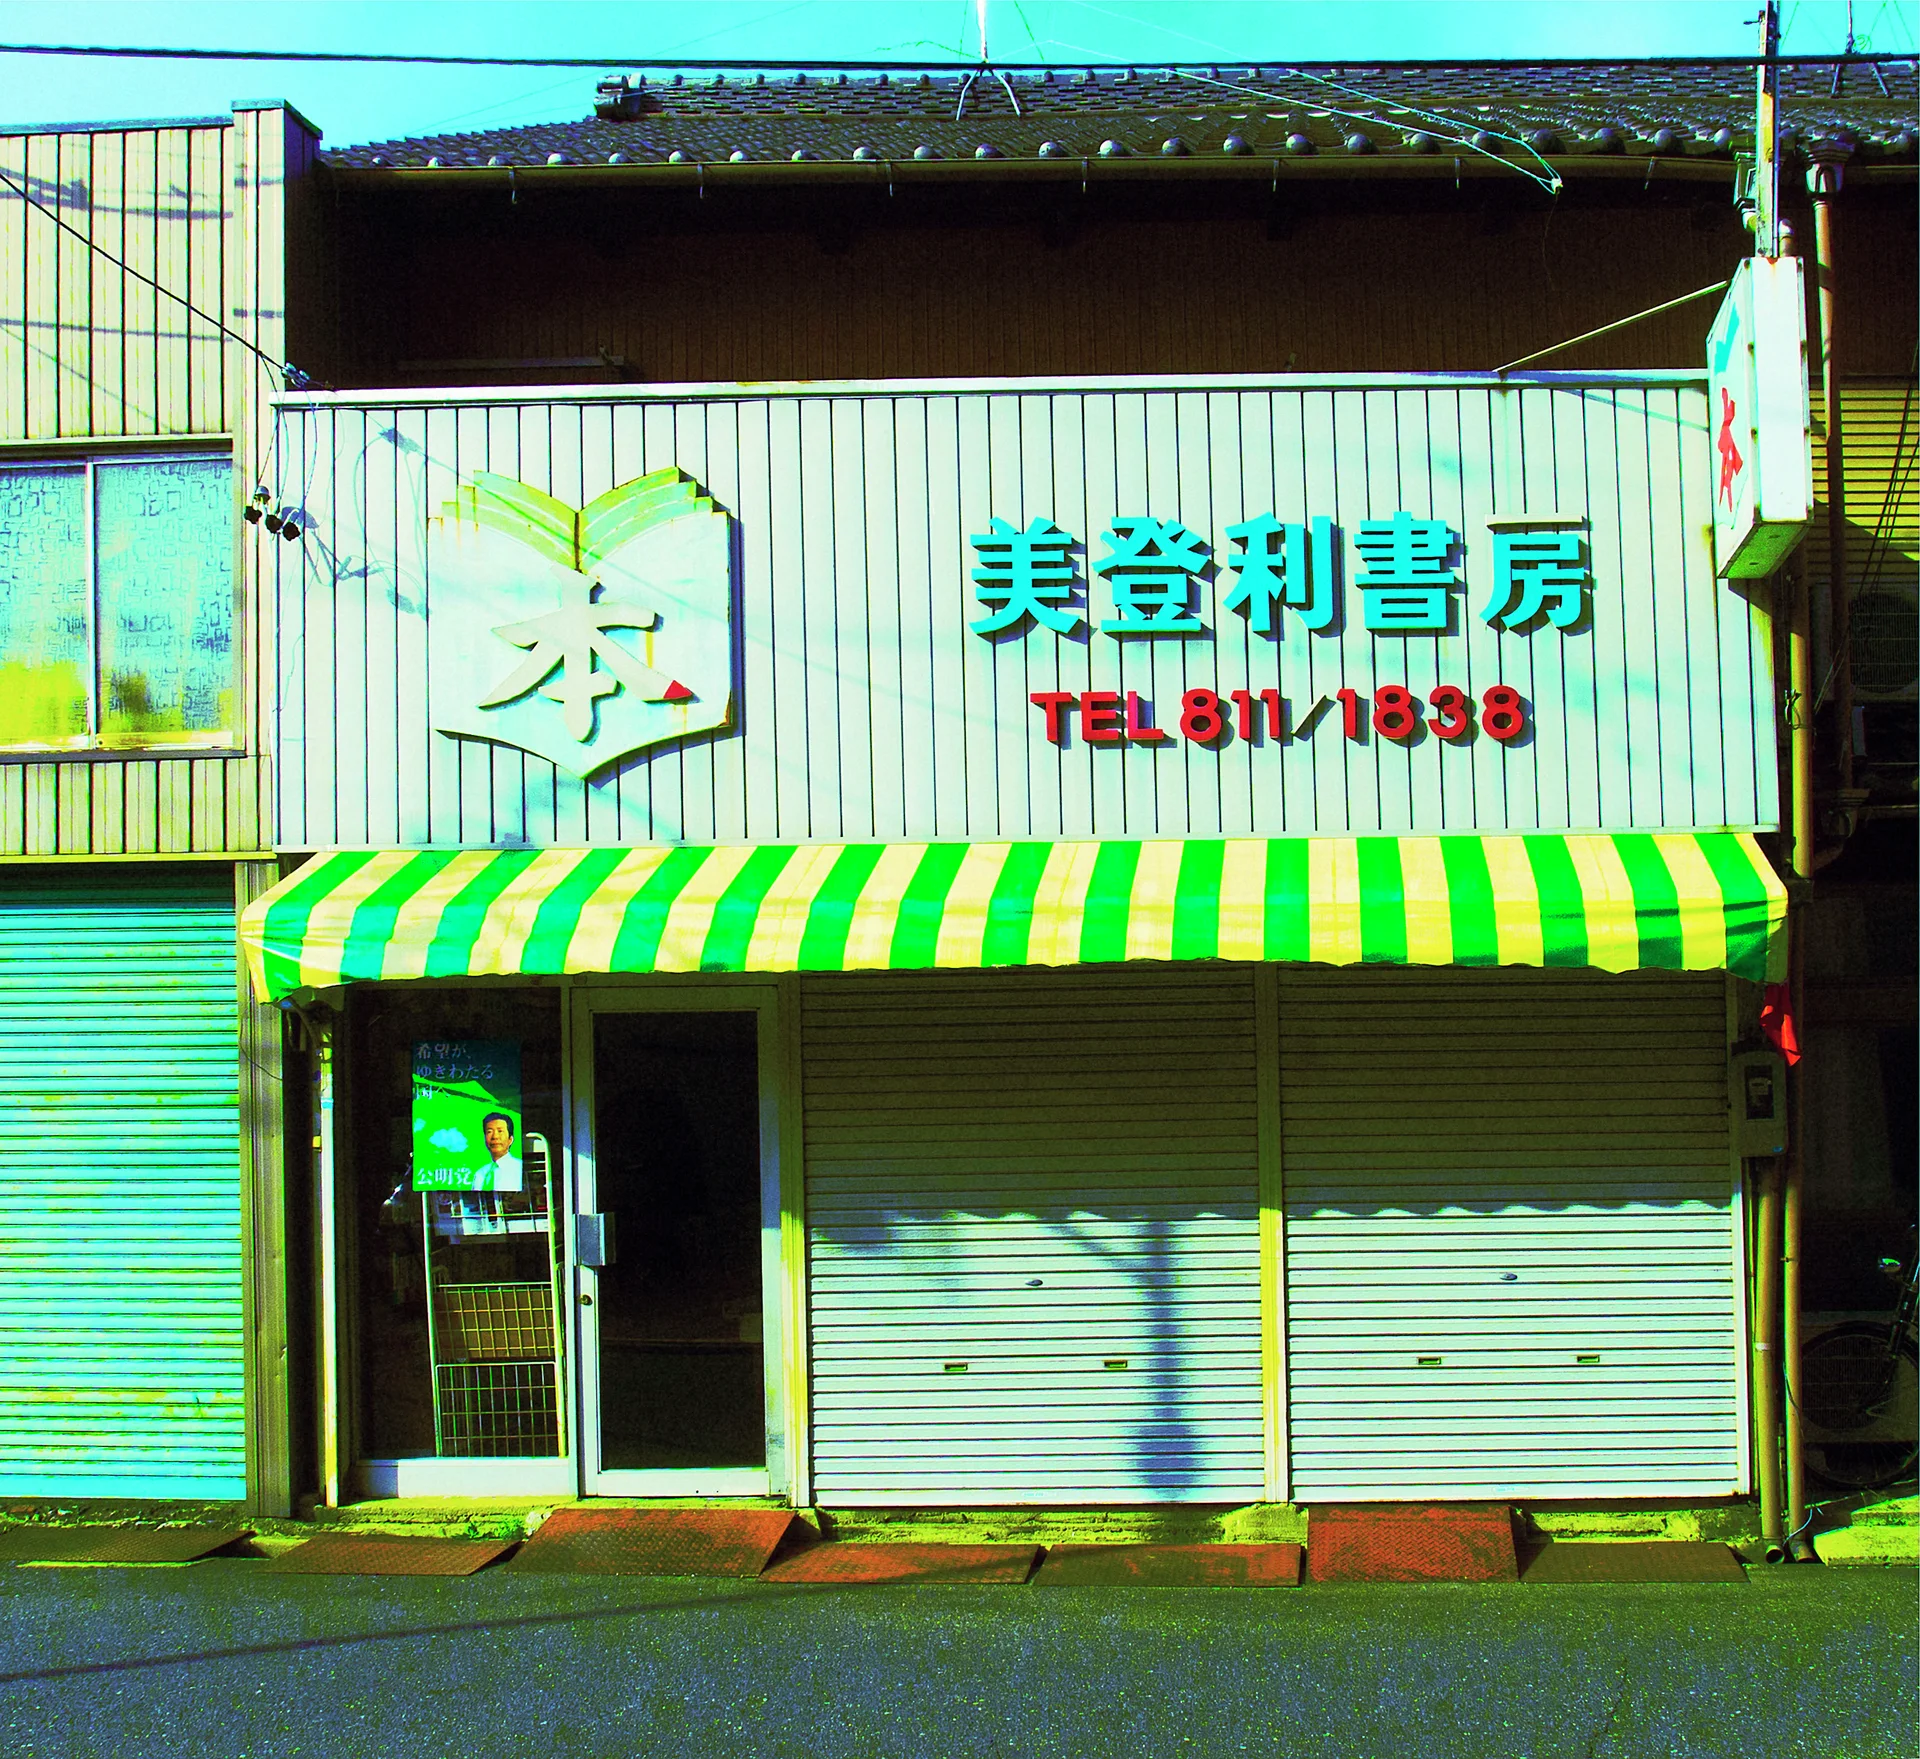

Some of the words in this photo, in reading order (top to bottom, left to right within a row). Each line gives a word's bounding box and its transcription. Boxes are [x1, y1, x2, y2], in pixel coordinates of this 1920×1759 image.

[969, 511, 1590, 634] 美登利書房
[476, 564, 694, 744] 本
[1030, 690, 1164, 742] TEL
[416, 1063, 495, 1080] ゆきわたる
[417, 1167, 473, 1186] 公明党
